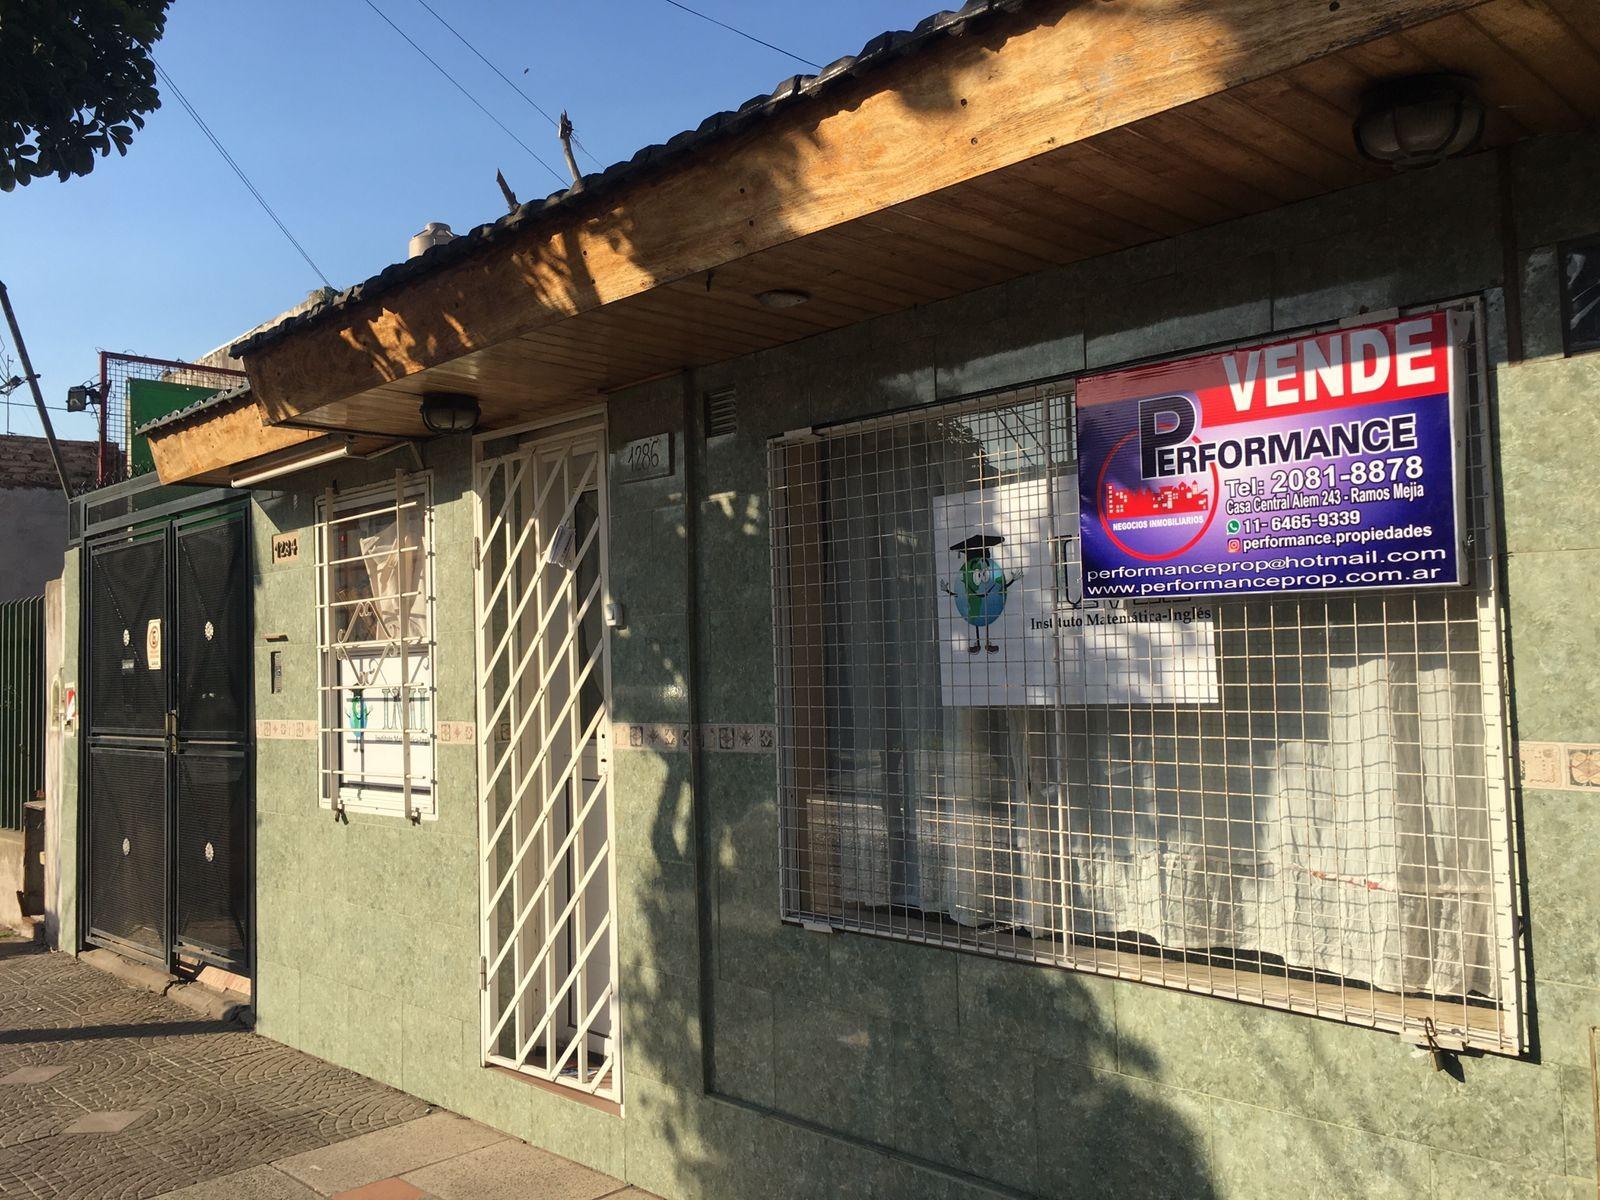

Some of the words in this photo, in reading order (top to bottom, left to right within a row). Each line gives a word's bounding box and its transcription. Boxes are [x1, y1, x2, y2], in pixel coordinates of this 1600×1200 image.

[1223, 319, 1435, 412] VENDE
[1138, 395, 1417, 480] PERFORMANCE
[628, 438, 660, 471] 1286
[1225, 478, 1264, 498] Tel:
[1271, 455, 1424, 494] 2081-8878
[1226, 499, 1251, 515] Casa
[1253, 494, 1289, 512] Central
[1292, 493, 1320, 508] Alem
[1322, 490, 1341, 505] 243
[1351, 486, 1390, 504] Ramos
[1393, 483, 1425, 502] Mejia
[1113, 520, 1148, 531] NEGOCIOS
[1149, 516, 1205, 529] INMOBILIARIOS
[1243, 518, 1267, 533] 11-
[1271, 510, 1361, 531] 6465-9339
[1243, 524, 1432, 552] performance.propiedades
[1087, 549, 1446, 582] performanceprop@hotmail.com
[1087, 567, 1442, 595] www.performanceprop.com.ar
[1031, 616, 1083, 630] Insttuto
